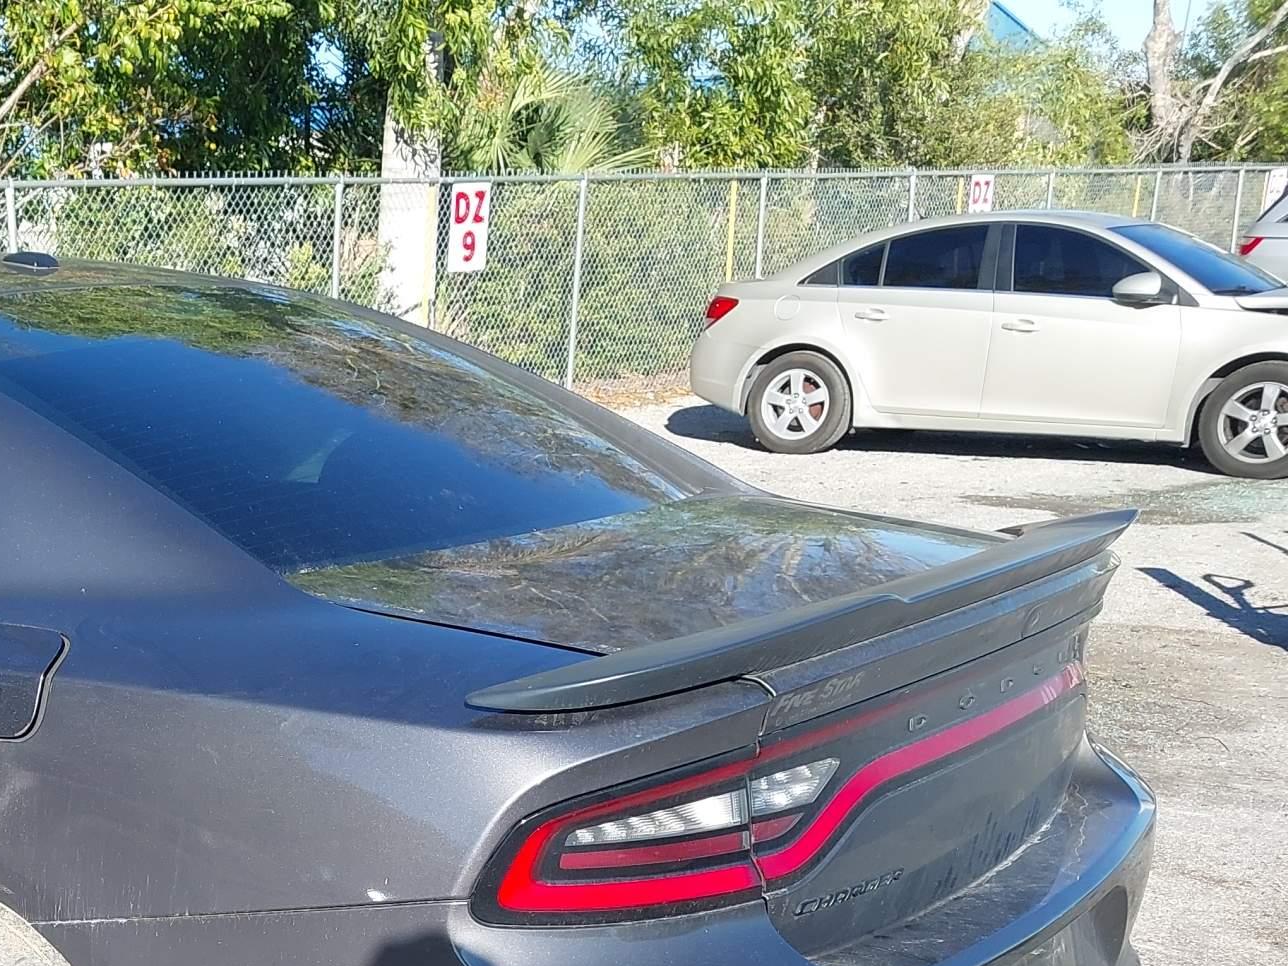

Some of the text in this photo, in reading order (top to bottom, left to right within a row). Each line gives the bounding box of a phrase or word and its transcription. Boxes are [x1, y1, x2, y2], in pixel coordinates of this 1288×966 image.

[454, 190, 486, 224] DZ
[972, 180, 991, 204] DZ
[463, 230, 476, 262] 9
[792, 866, 904, 917] CHARGER
